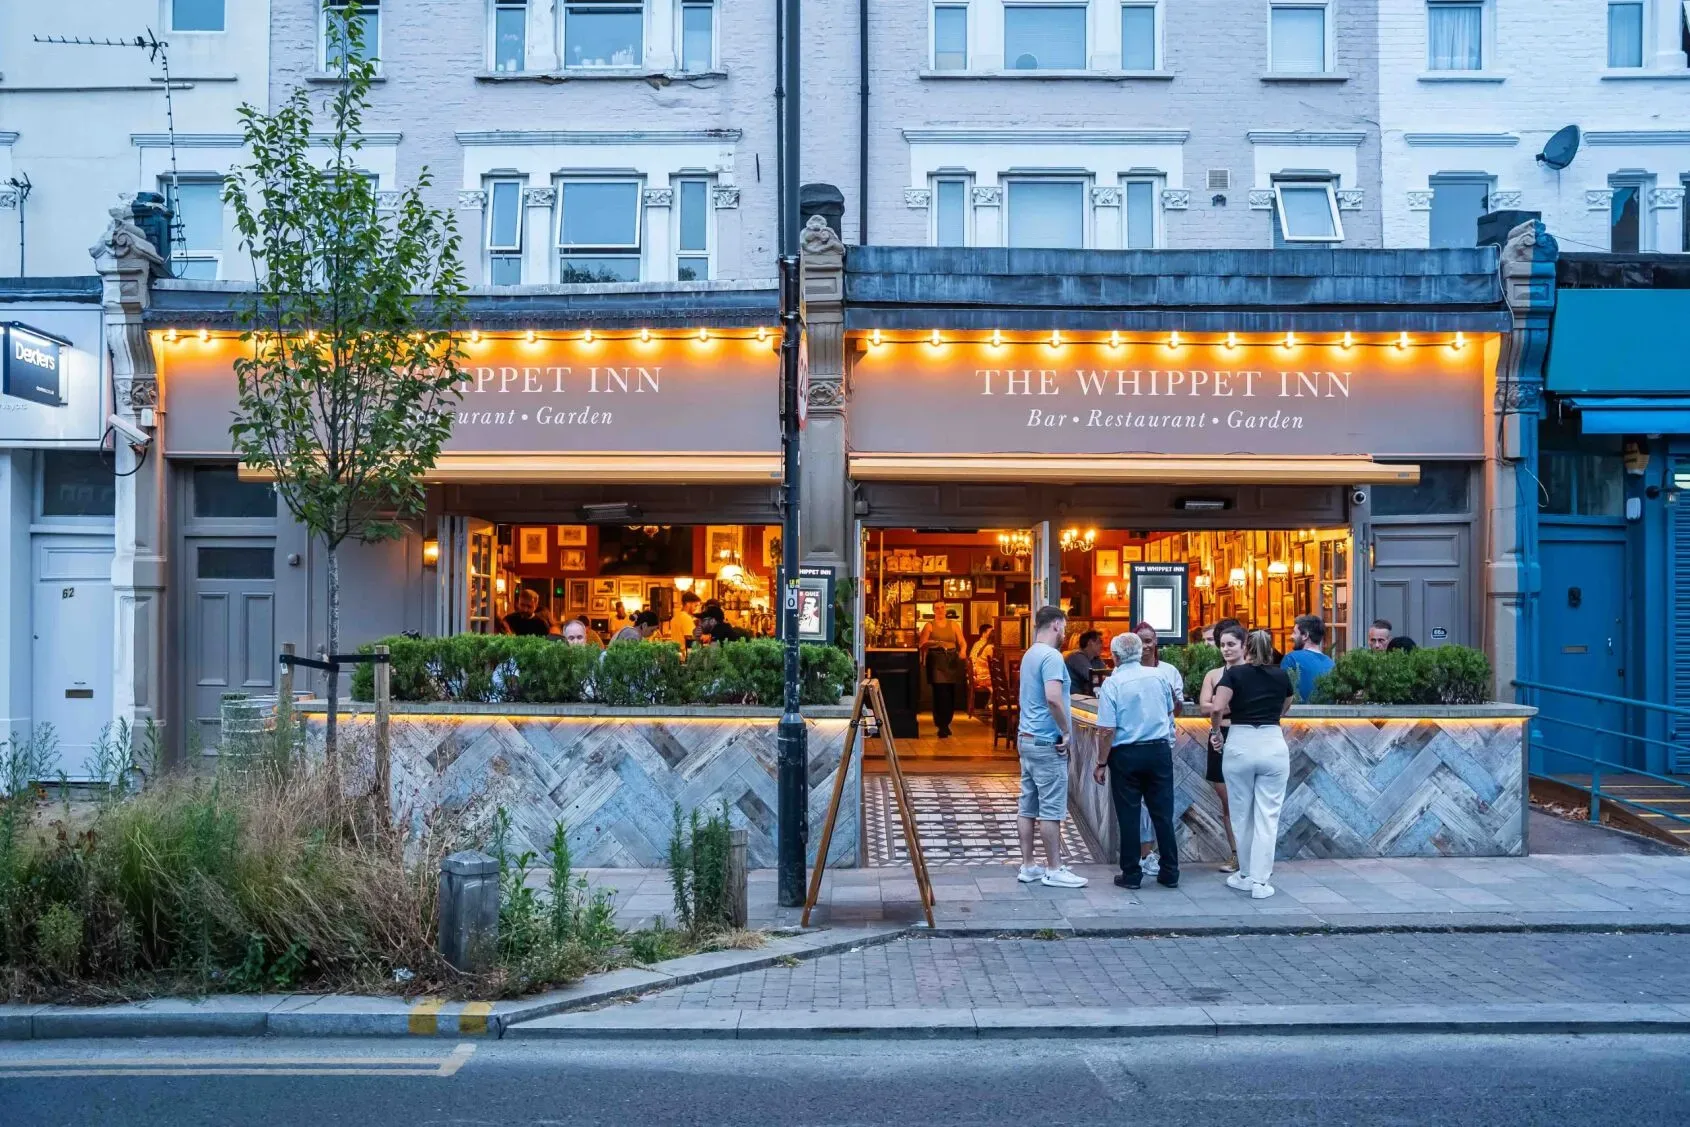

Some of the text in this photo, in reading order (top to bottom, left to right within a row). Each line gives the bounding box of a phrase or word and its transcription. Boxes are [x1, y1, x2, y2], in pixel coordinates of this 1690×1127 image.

[15, 341, 55, 371] Dexters
[588, 366, 663, 394] INN
[975, 369, 1352, 398] THE WHIPPET INN
[536, 405, 613, 425] Garden
[1026, 409, 1304, 430] Bar Restaurant Garden
[62, 587, 75, 599] 62
